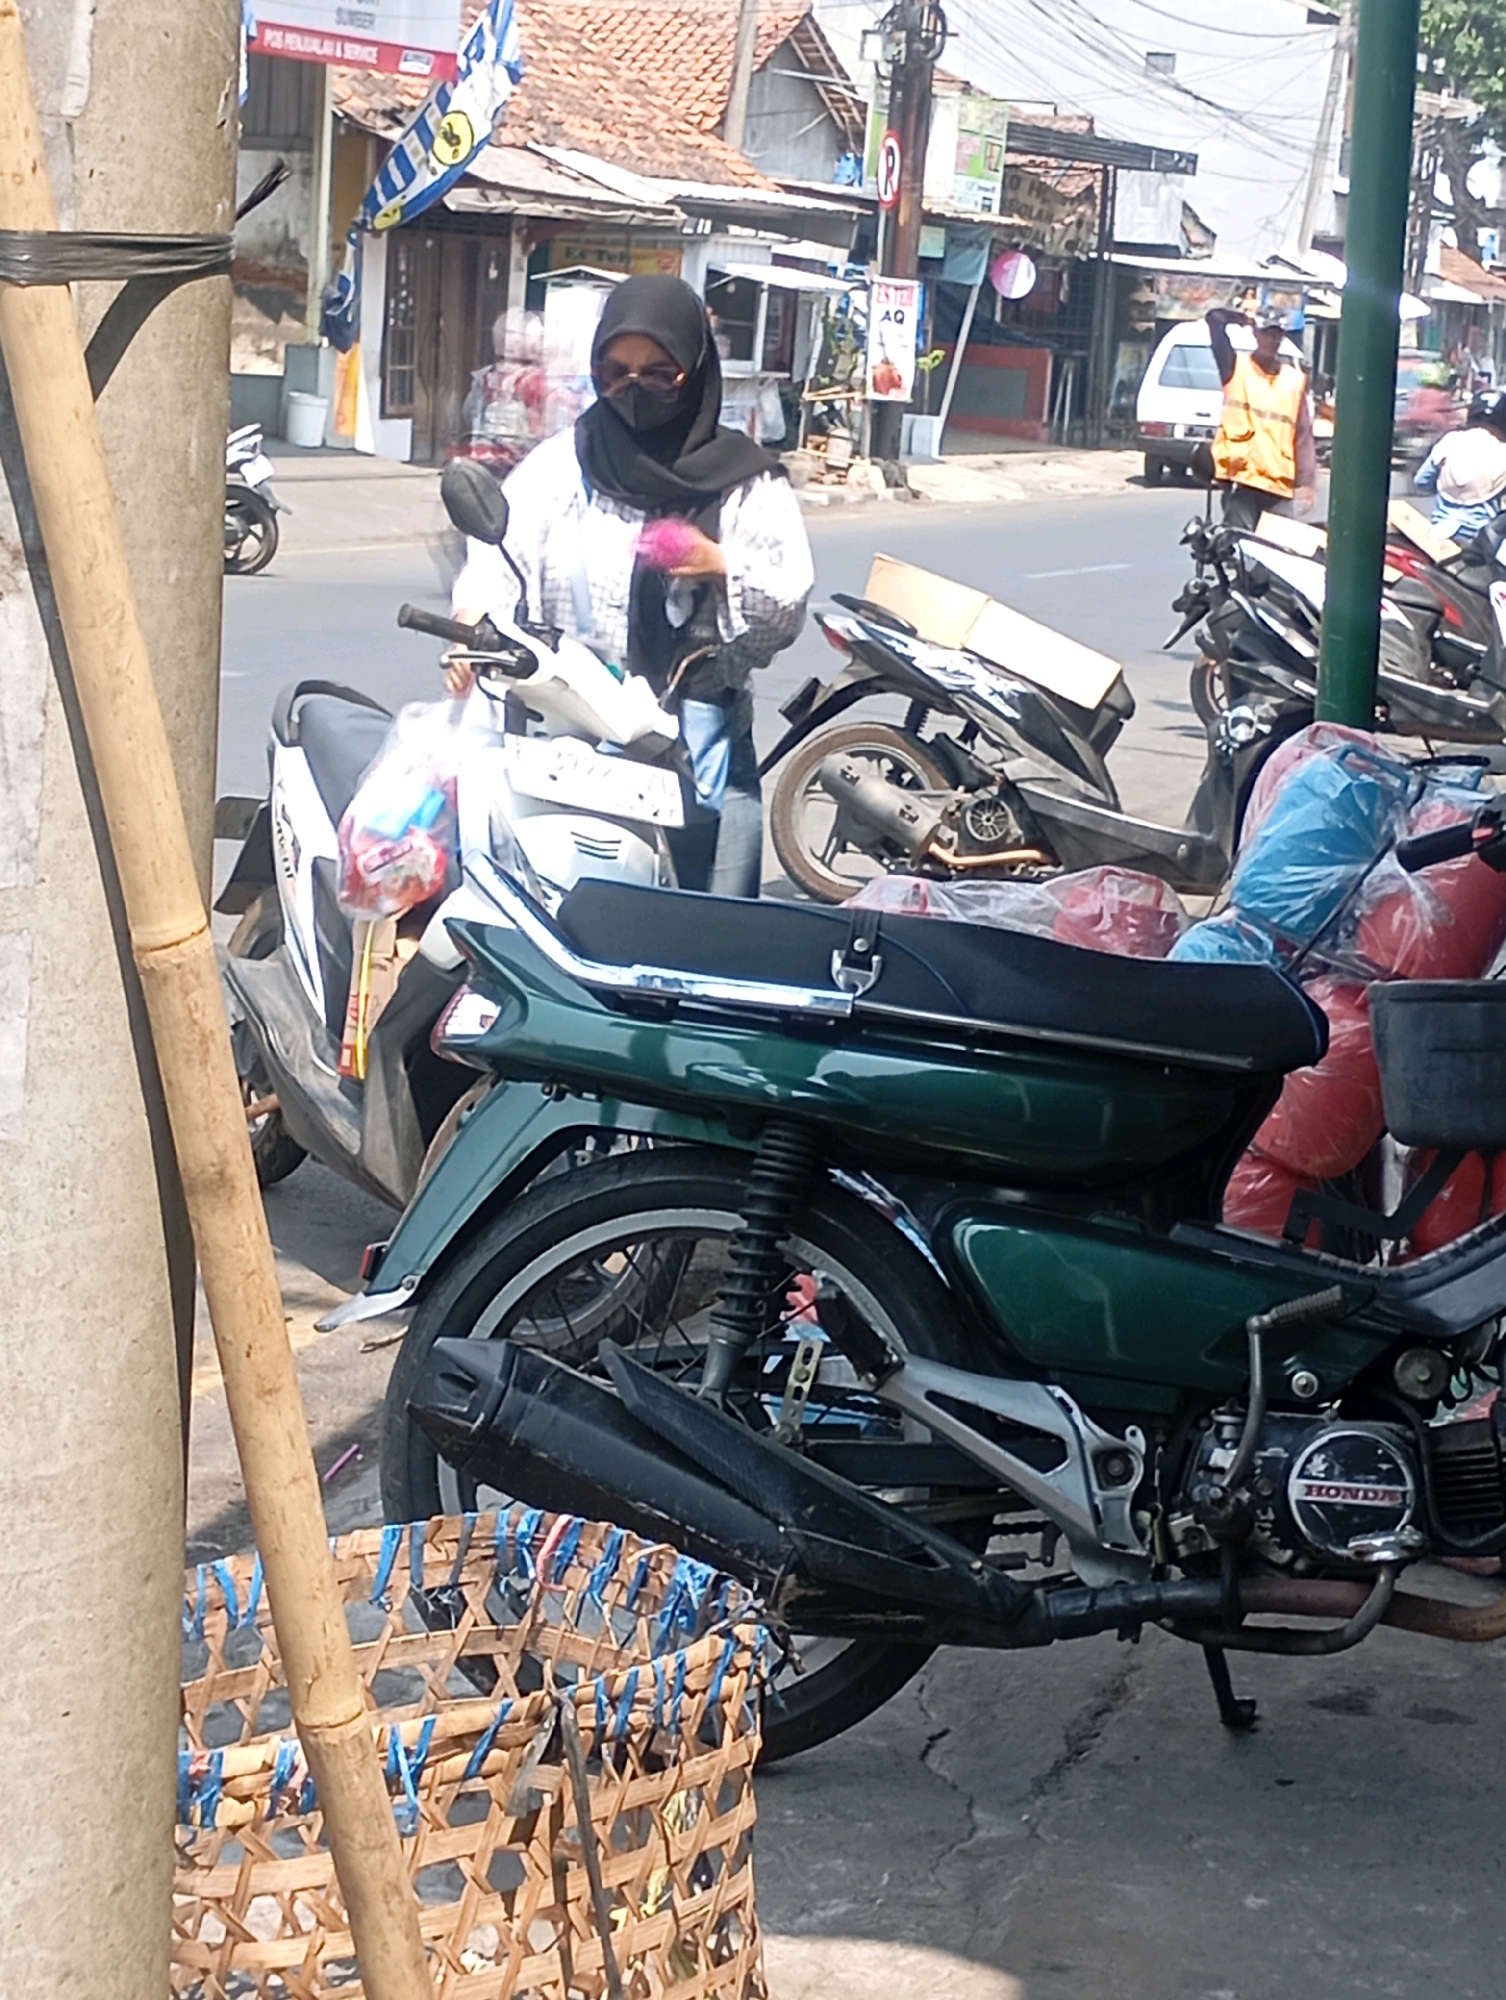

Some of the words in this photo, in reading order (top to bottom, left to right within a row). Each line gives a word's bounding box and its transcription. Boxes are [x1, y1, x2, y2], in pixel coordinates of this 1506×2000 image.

[335, 6, 376, 30] SUMBER
[263, 29, 283, 49] POS
[284, 33, 334, 57] PENJUALAN
[343, 42, 378, 65] SERVICE
[879, 309, 906, 325] AQ
[1304, 1484, 1400, 1504] HONDA
